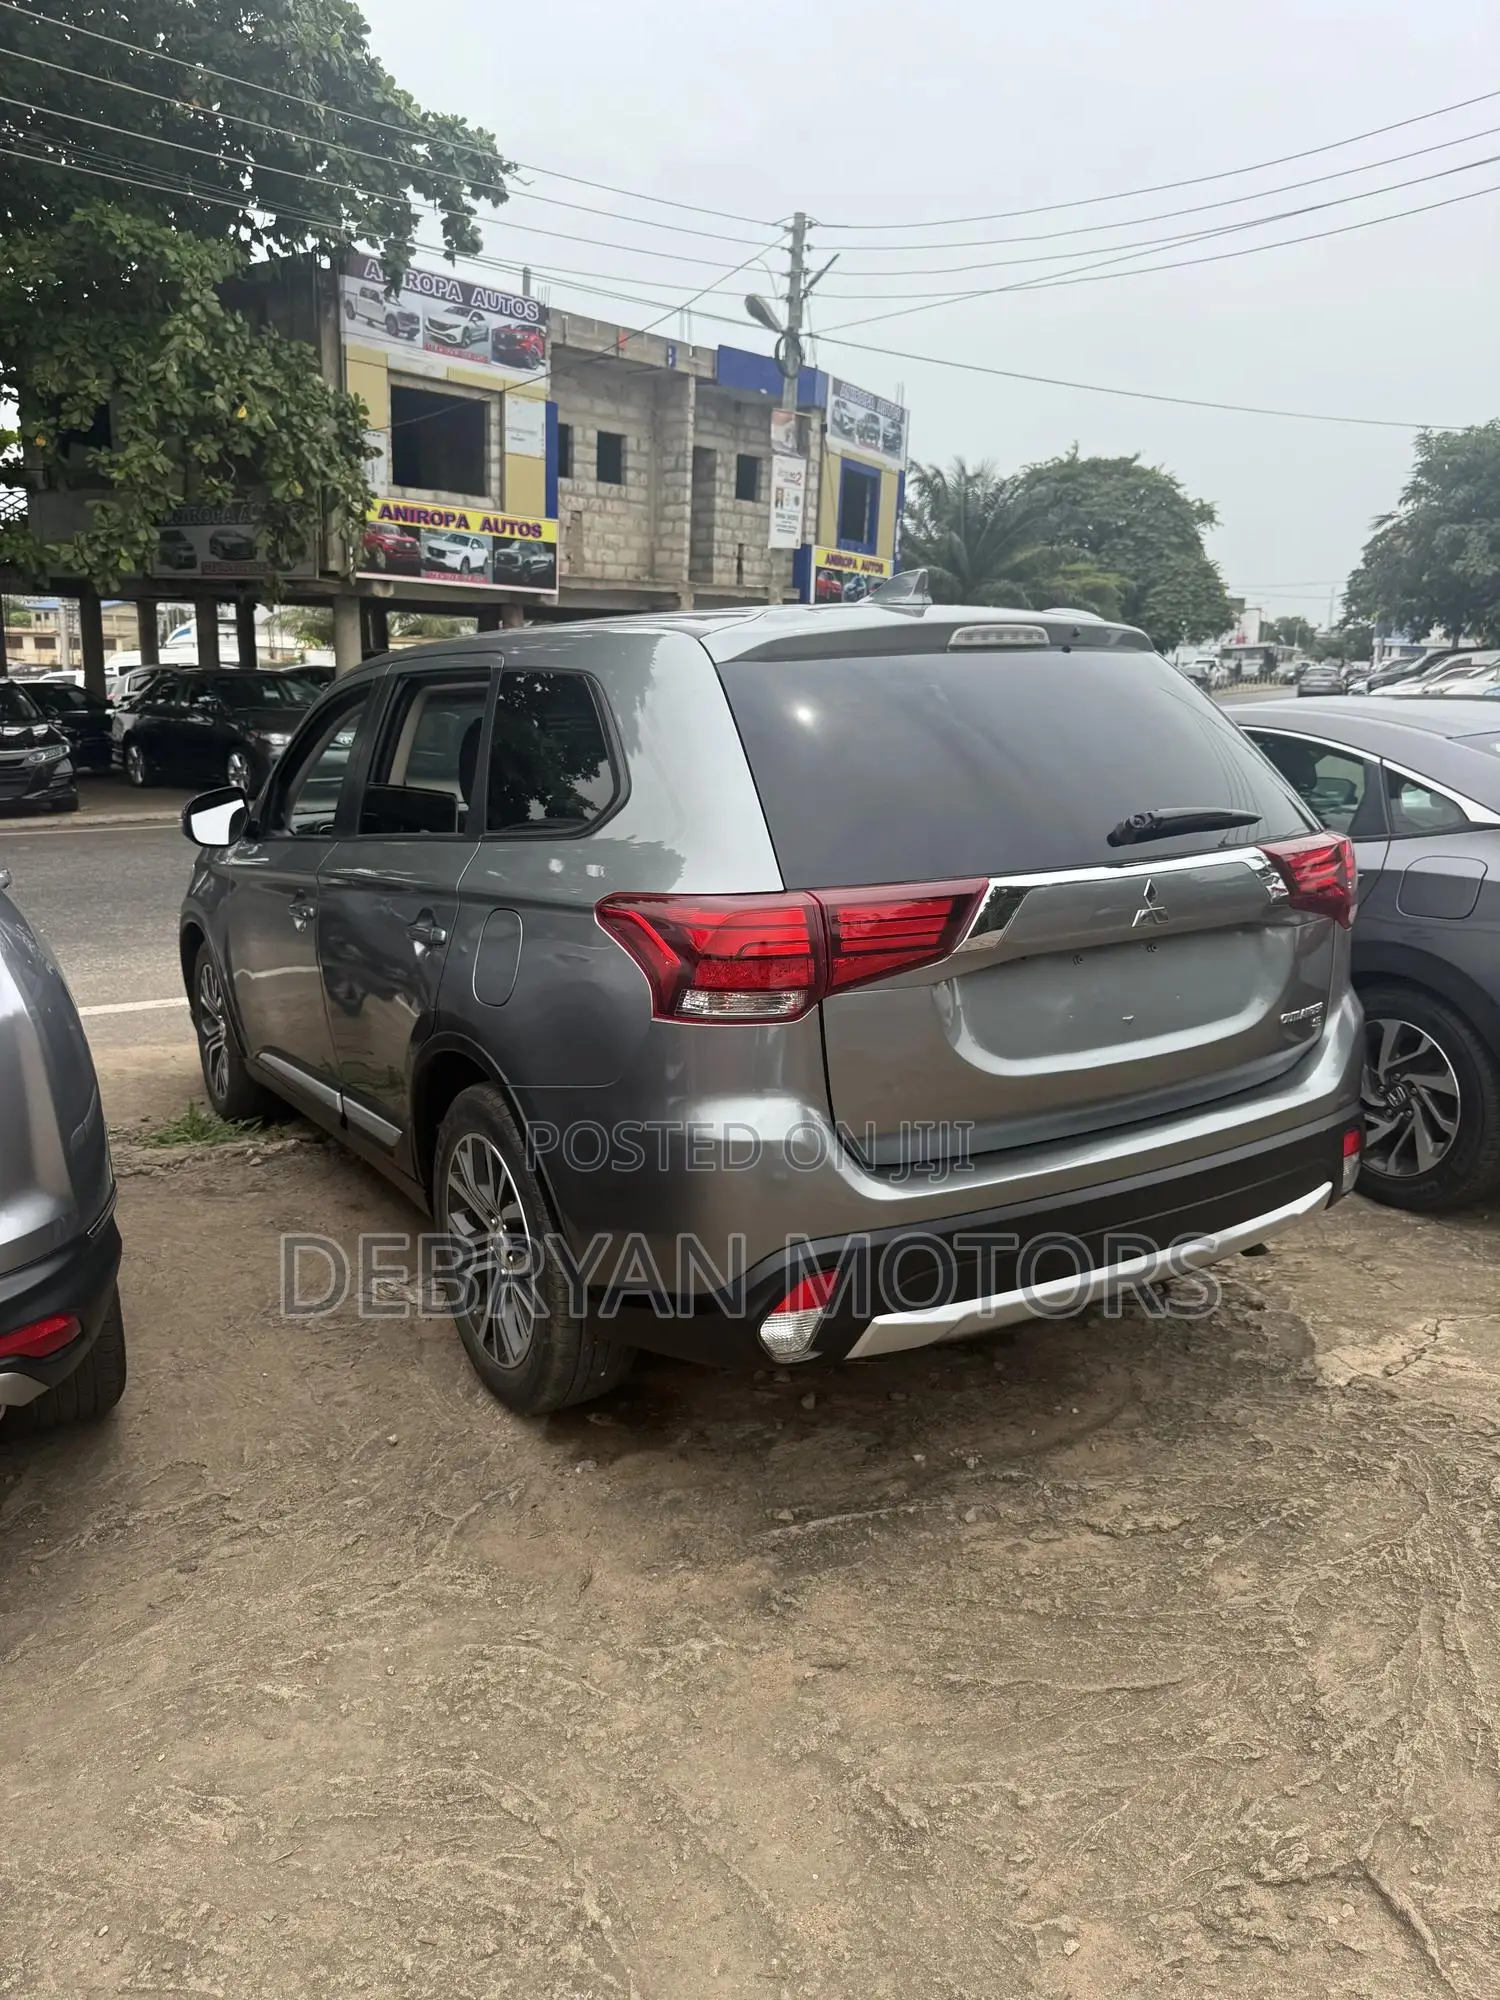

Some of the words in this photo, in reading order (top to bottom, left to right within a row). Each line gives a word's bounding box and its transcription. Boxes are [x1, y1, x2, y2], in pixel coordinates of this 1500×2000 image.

[364, 258, 463, 303] AROPA
[471, 287, 539, 321] AUTOS
[378, 503, 470, 530] ANIROPA
[480, 516, 542, 538] AUTOS
